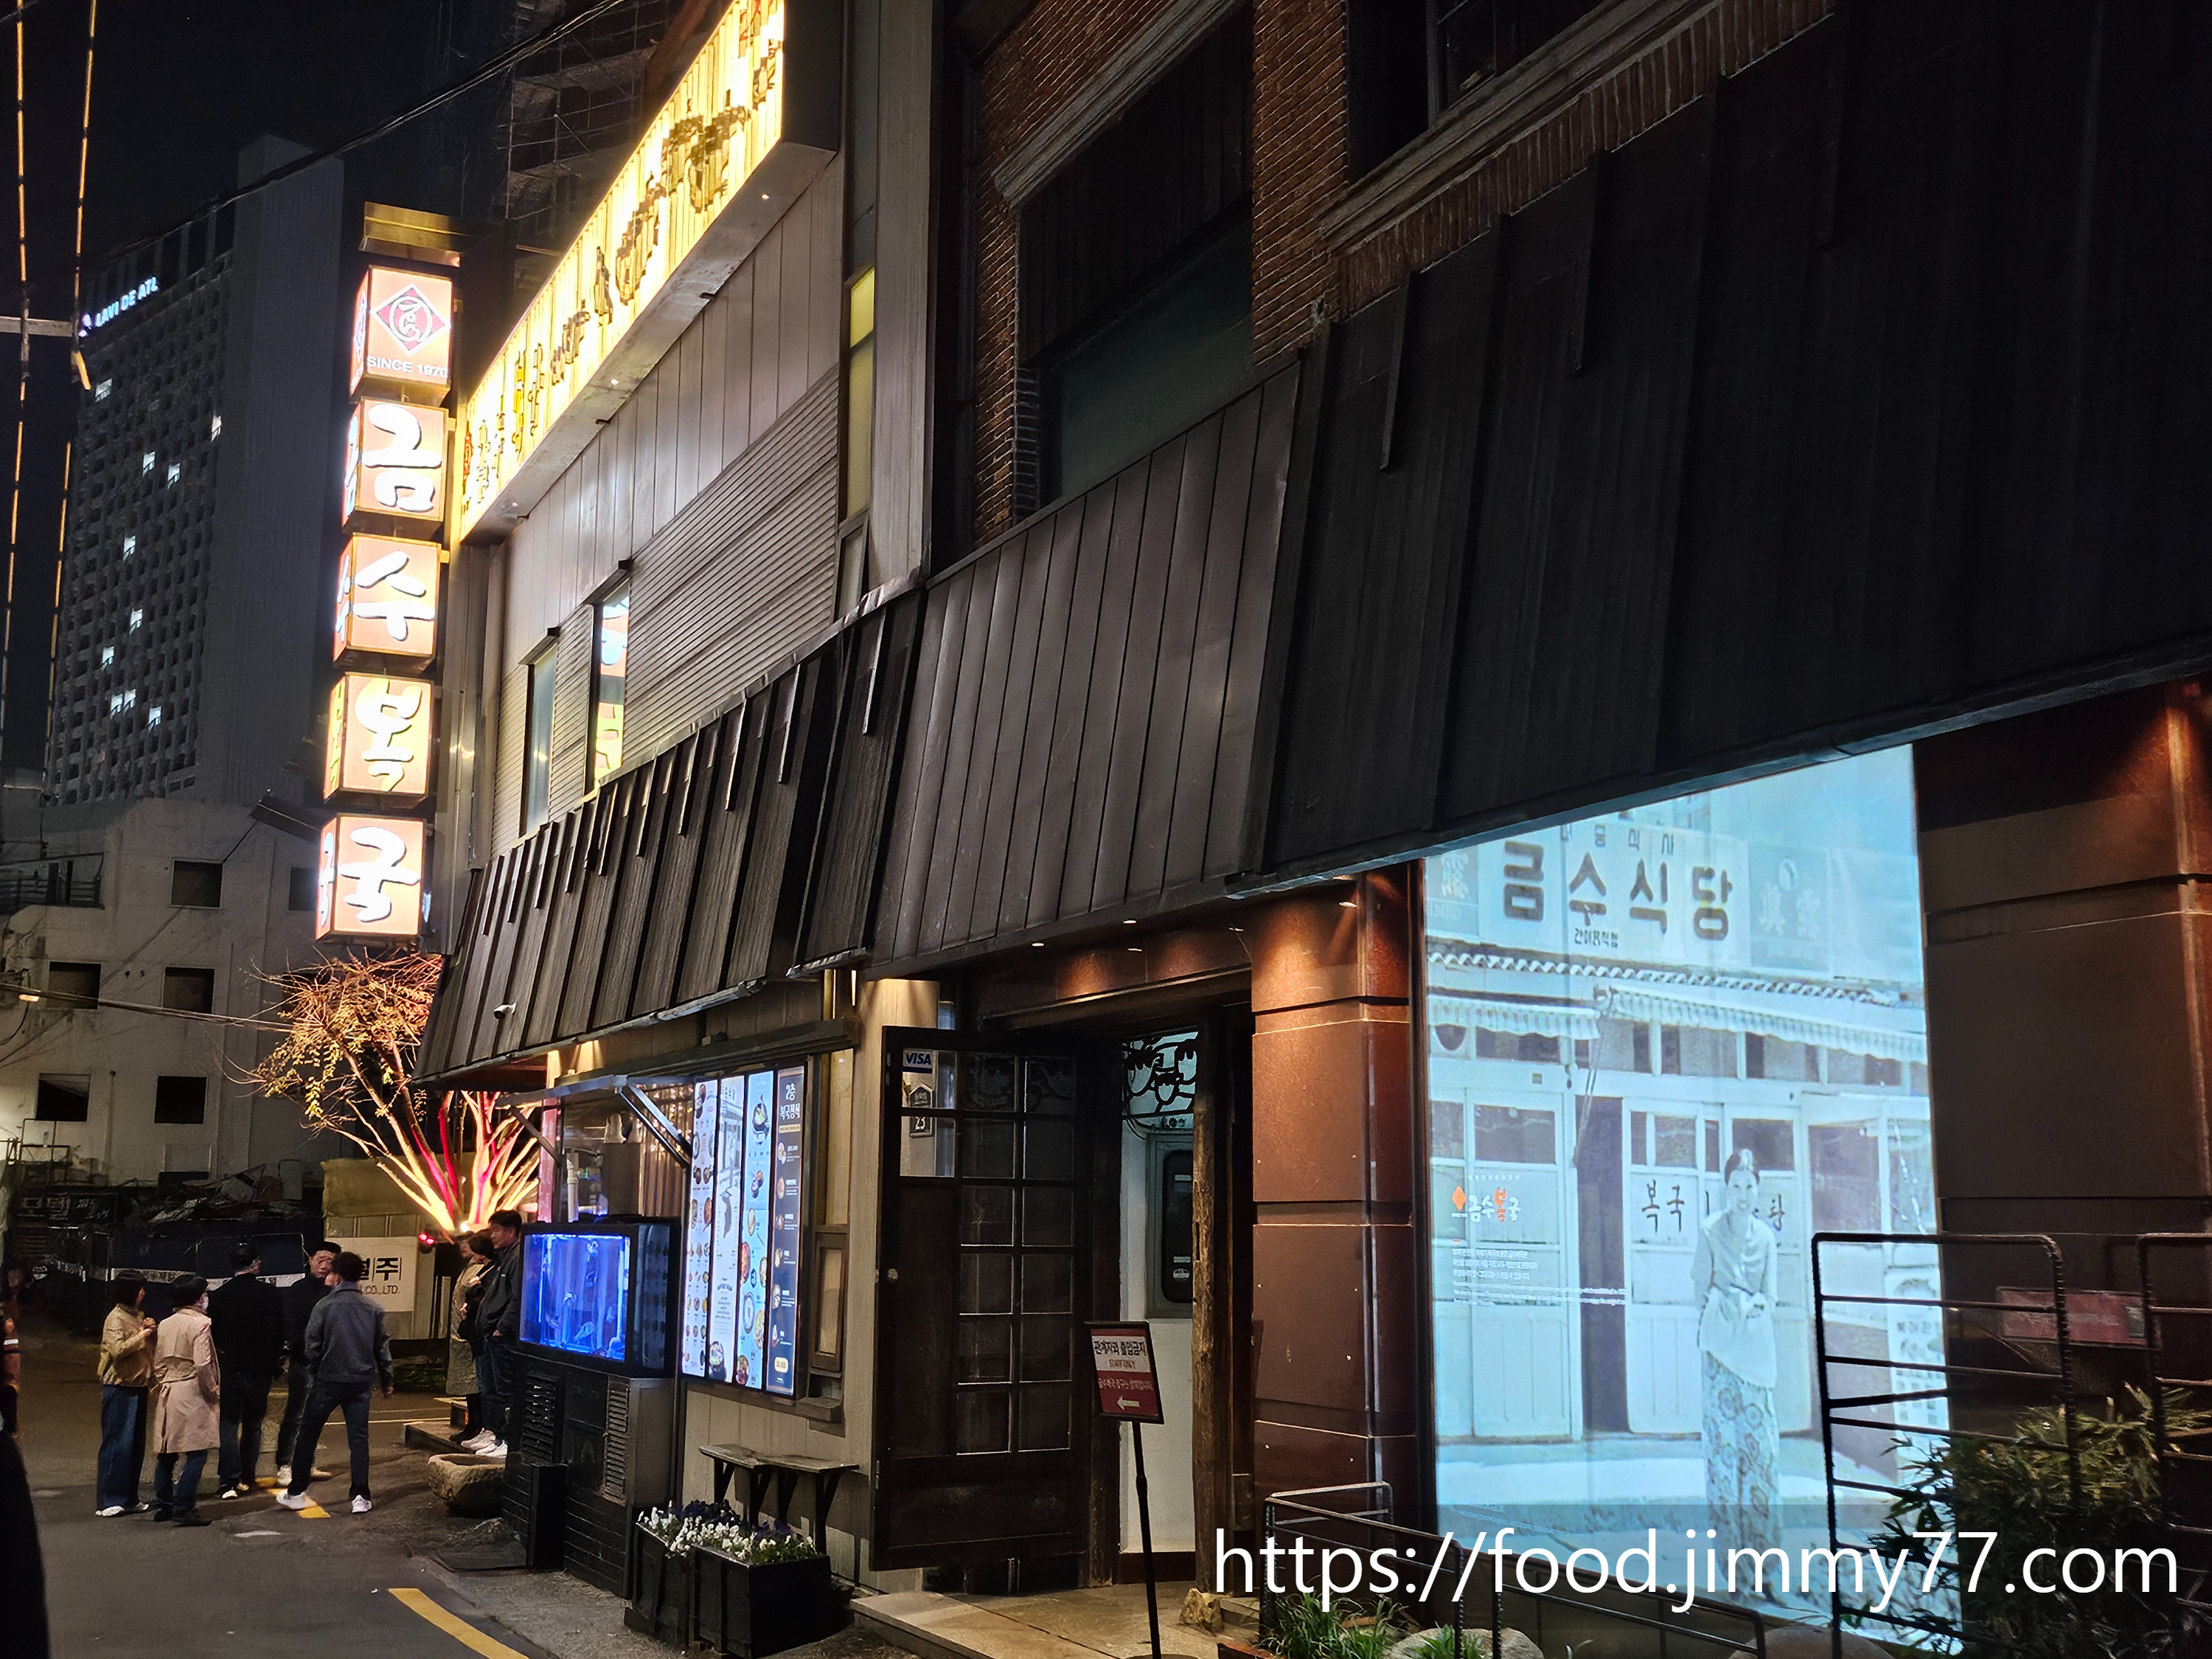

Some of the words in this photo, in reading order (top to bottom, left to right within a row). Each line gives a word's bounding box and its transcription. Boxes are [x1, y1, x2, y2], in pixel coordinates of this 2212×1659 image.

[121, 289, 137, 311] DE
[366, 355, 413, 373] SINCE
[416, 363, 448, 379] 1970
[338, 403, 442, 922] 금수복국
[1503, 840, 1733, 942] 금수식당
[906, 1052, 932, 1065] VISA
[1468, 1186, 1521, 1223] 금수복국
[1641, 1179, 1686, 1233] 복국
